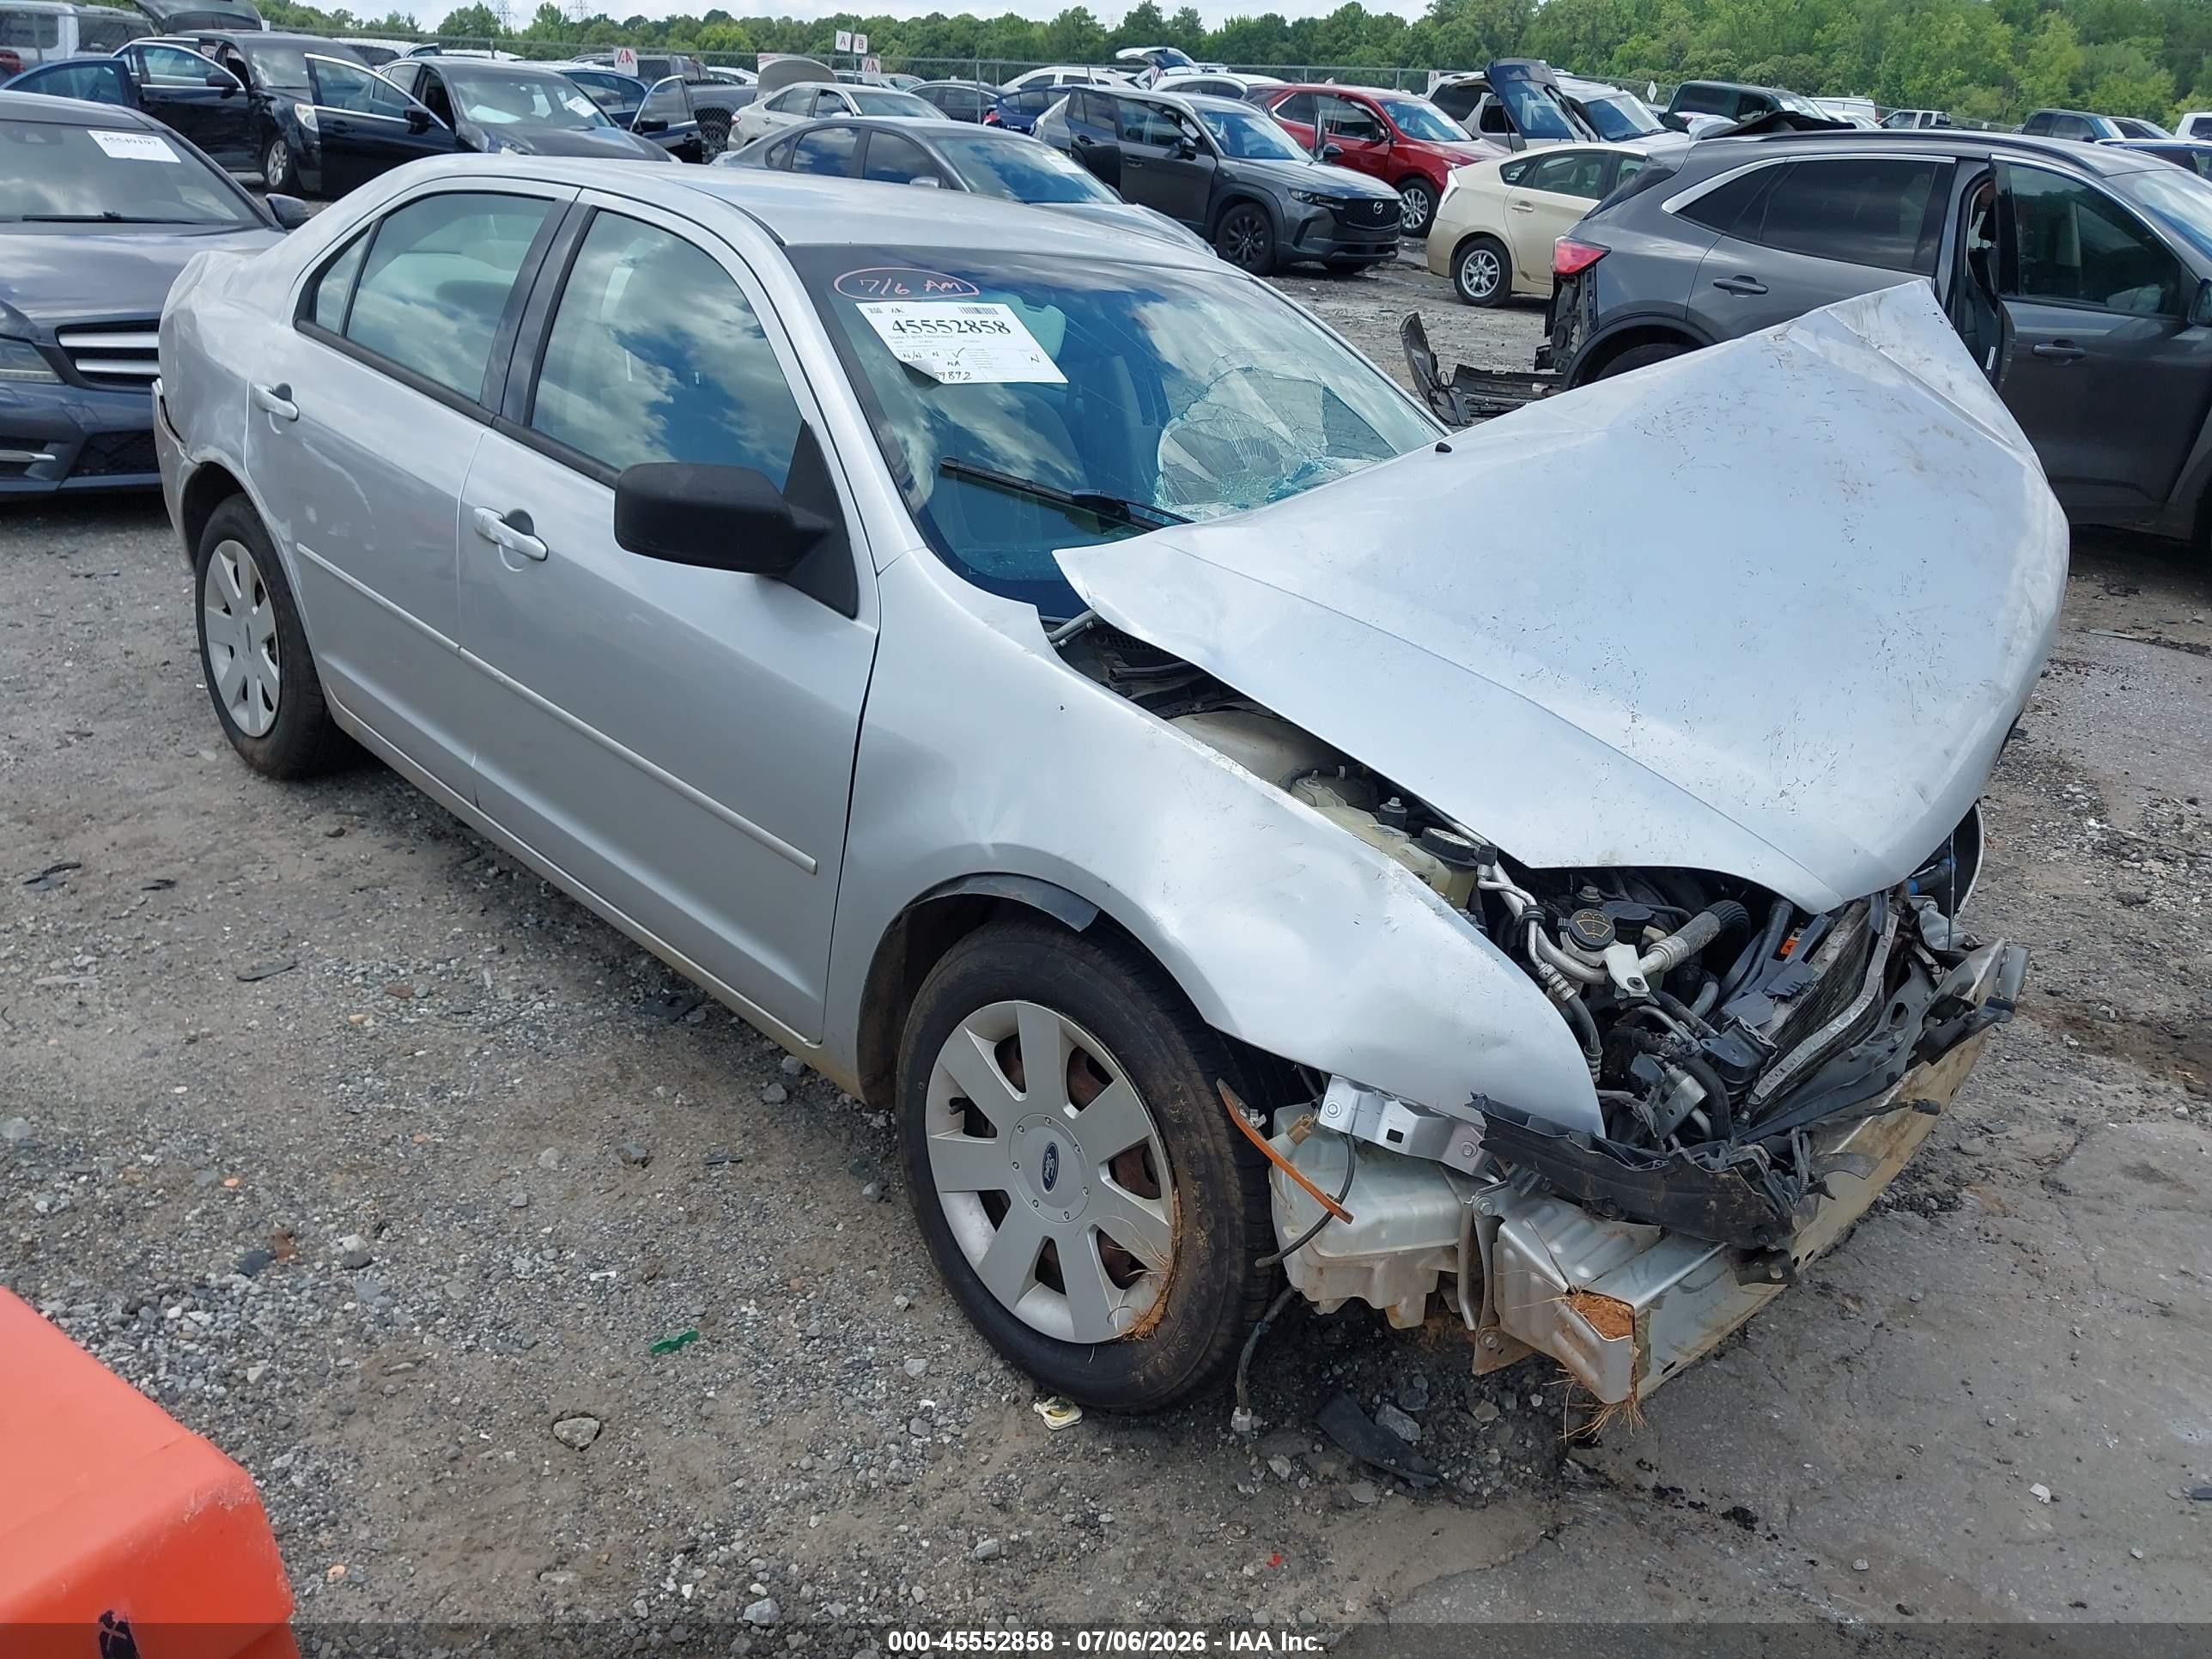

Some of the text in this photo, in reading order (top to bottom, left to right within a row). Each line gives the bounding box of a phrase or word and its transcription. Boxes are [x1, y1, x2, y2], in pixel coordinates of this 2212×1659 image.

[839, 35, 847, 46] A
[859, 39, 864, 49] B
[860, 277, 963, 295] 7/6 AM
[892, 319, 1011, 334] 45552858
